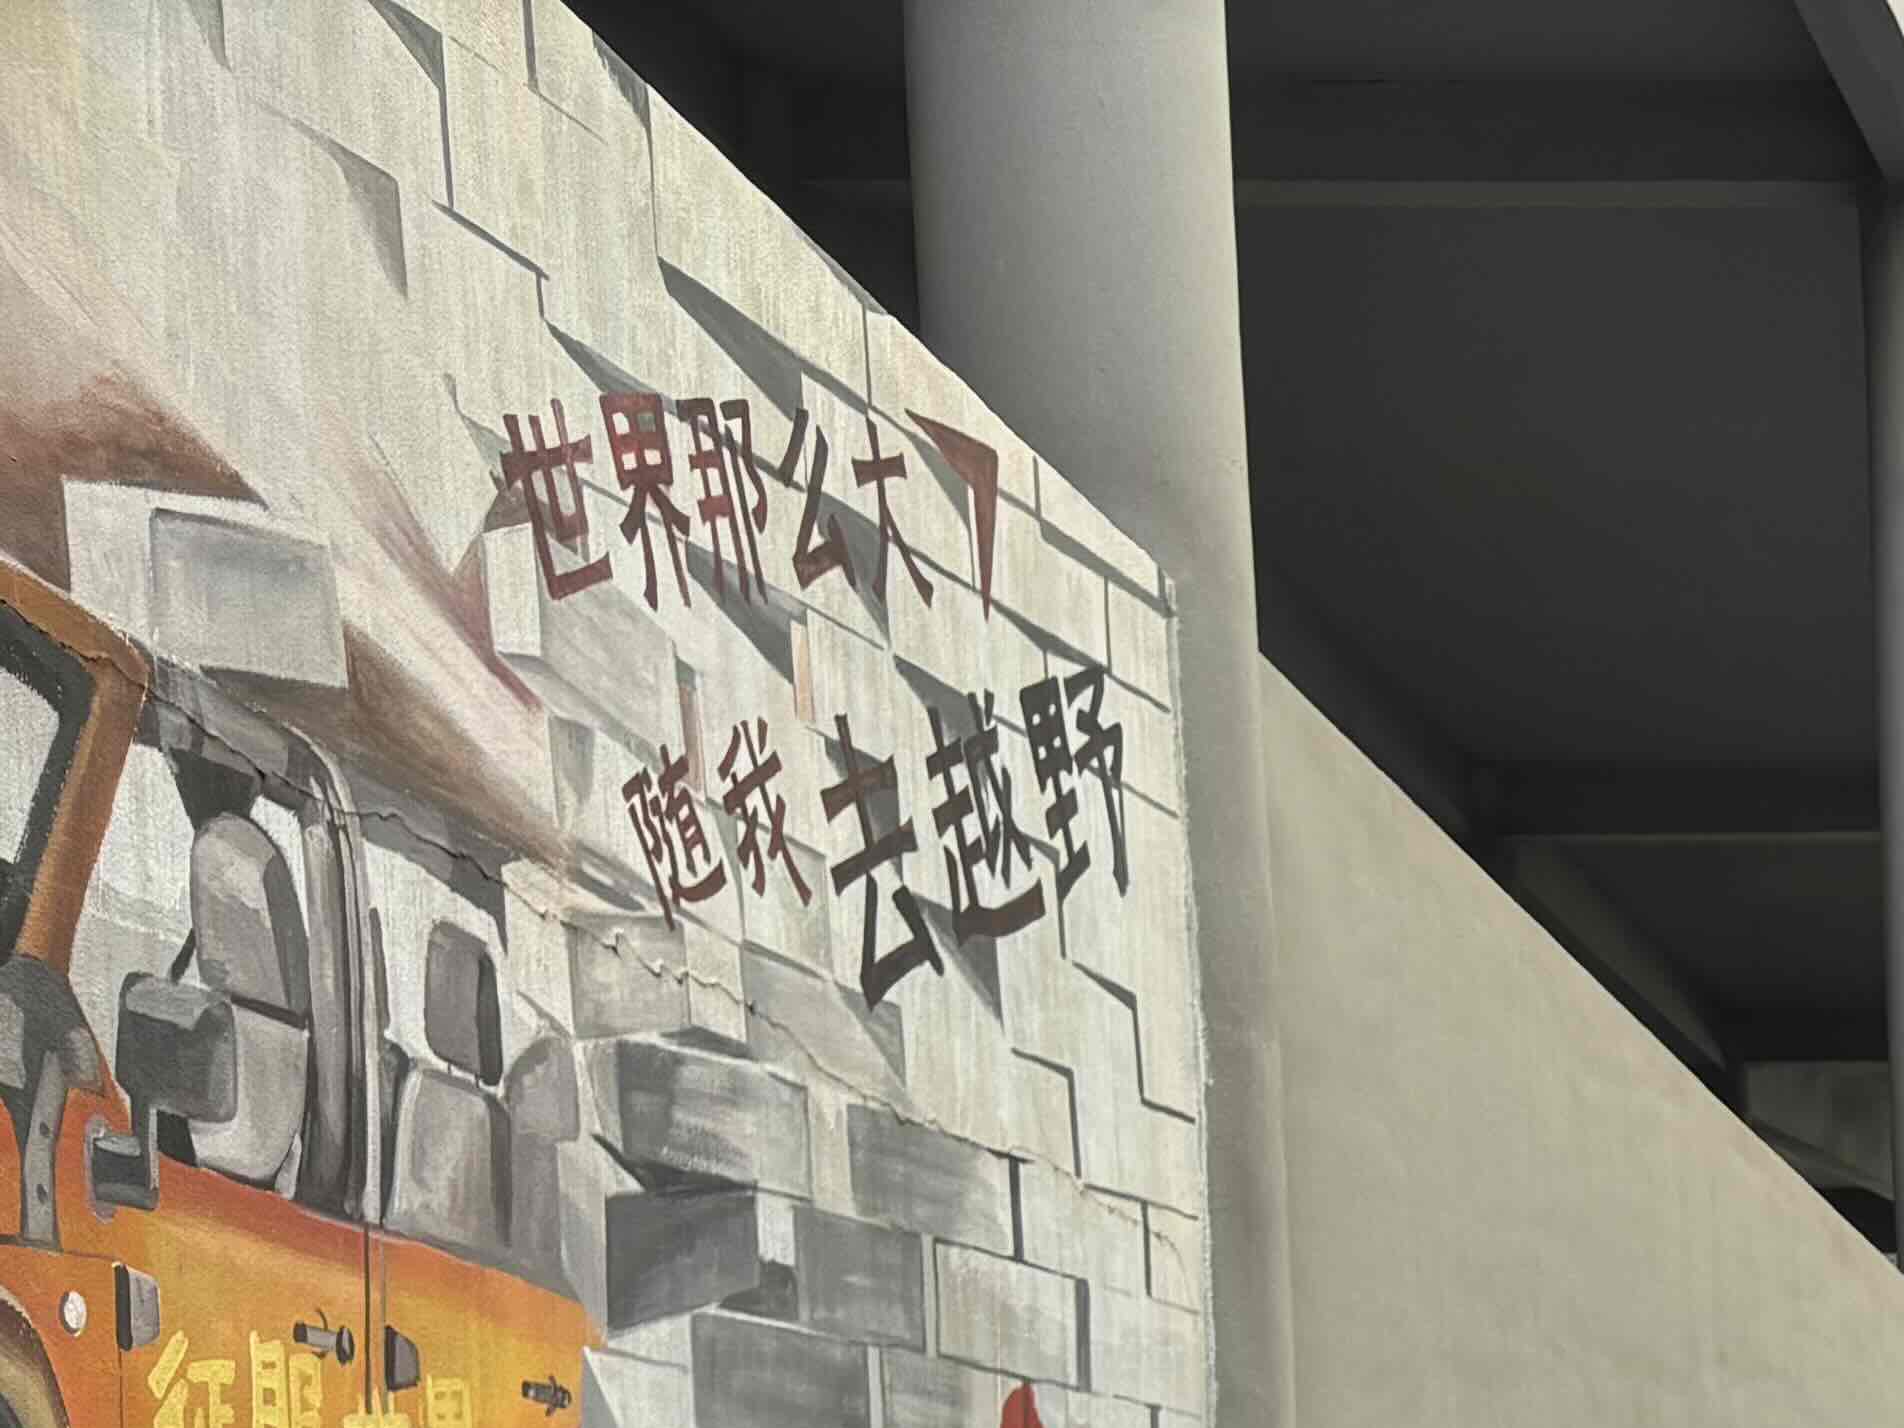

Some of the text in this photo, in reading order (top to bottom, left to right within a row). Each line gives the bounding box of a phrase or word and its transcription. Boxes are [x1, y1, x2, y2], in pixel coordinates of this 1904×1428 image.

[622, 664, 1129, 1009] 随我去越野
